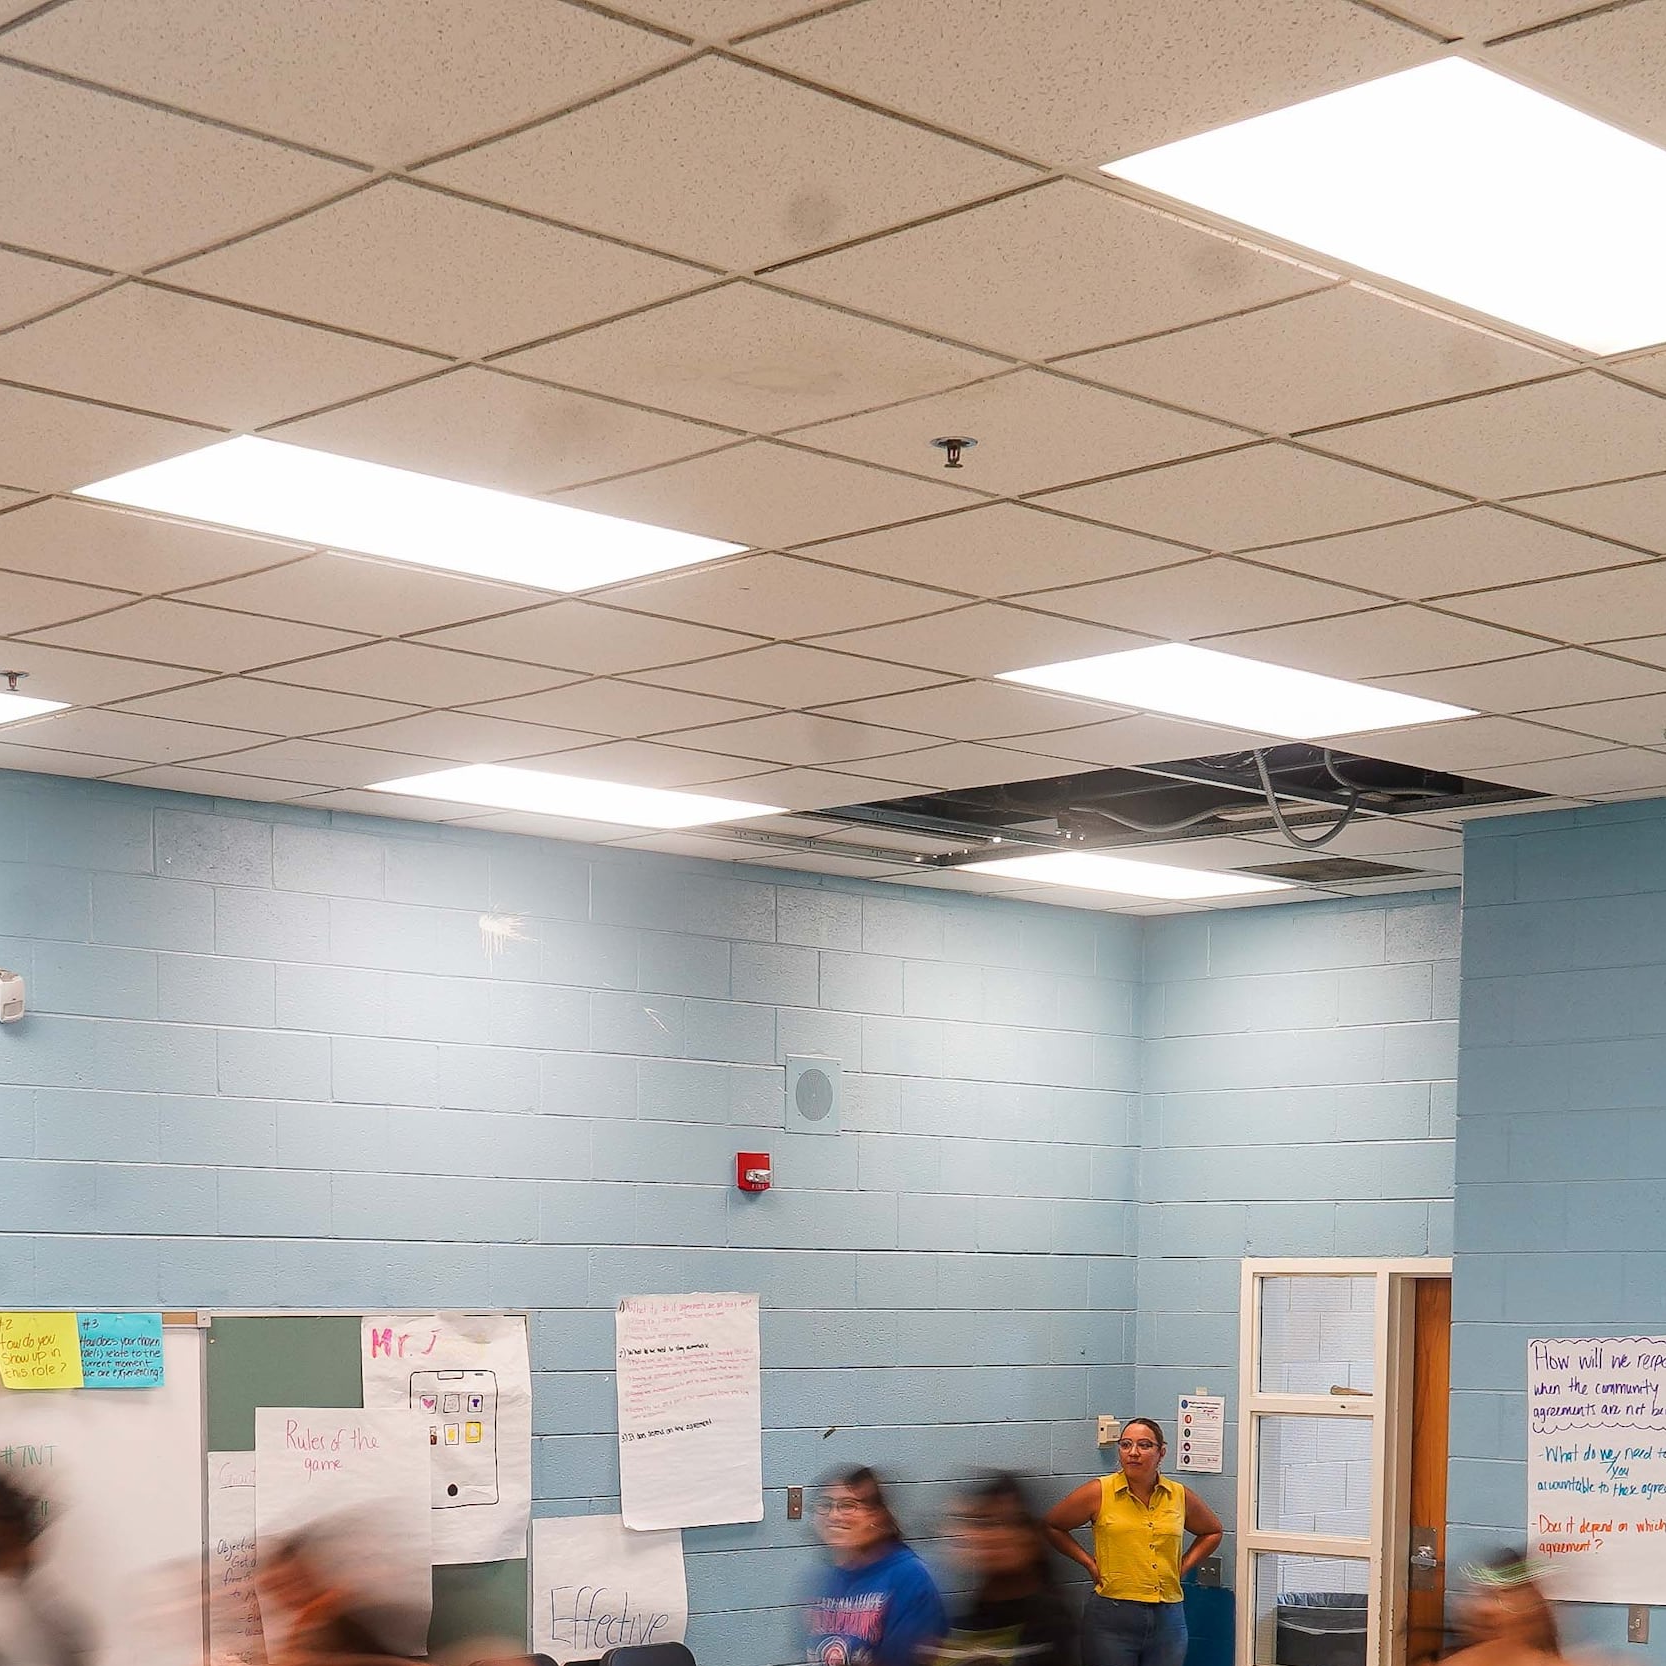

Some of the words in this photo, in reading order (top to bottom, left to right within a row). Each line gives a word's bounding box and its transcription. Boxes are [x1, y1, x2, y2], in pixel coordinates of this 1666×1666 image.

[82, 1317, 100, 1331] #3
[23, 1334, 35, 1348] do
[38, 1333, 56, 1350] you
[96, 1335, 118, 1347] does
[33, 1351, 46, 1366] up
[49, 1347, 61, 1360] in
[106, 1349, 129, 1358] relate
[132, 1348, 142, 1358] to
[143, 1349, 161, 1358] the
[1534, 1345, 1570, 1371] How
[1579, 1347, 1603, 1370] will
[1611, 1354, 1632, 1369] we
[4, 1366, 28, 1379] this
[114, 1359, 153, 1368] moment
[112, 1366, 164, 1382] experiencing?
[1533, 1382, 1561, 1397] when
[1568, 1376, 1588, 1396] the
[1595, 1378, 1660, 1402] community
[1533, 1402, 1596, 1424] agreements
[1601, 1404, 1622, 1416] are
[1625, 1403, 1646, 1416] not
[285, 1418, 326, 1450] Rules
[330, 1428, 347, 1452] of
[349, 1424, 381, 1450] the
[1583, 1443, 1596, 1460] do
[1599, 1448, 1617, 1464] we
[1624, 1446, 1652, 1460] need
[303, 1457, 343, 1480] game
[1537, 1476, 1595, 1494] accountable
[1598, 1481, 1609, 1494] to
[1565, 1515, 1575, 1534] it
[1579, 1516, 1614, 1539] depend
[1617, 1521, 1628, 1532] on
[550, 1585, 669, 1650] Effective
